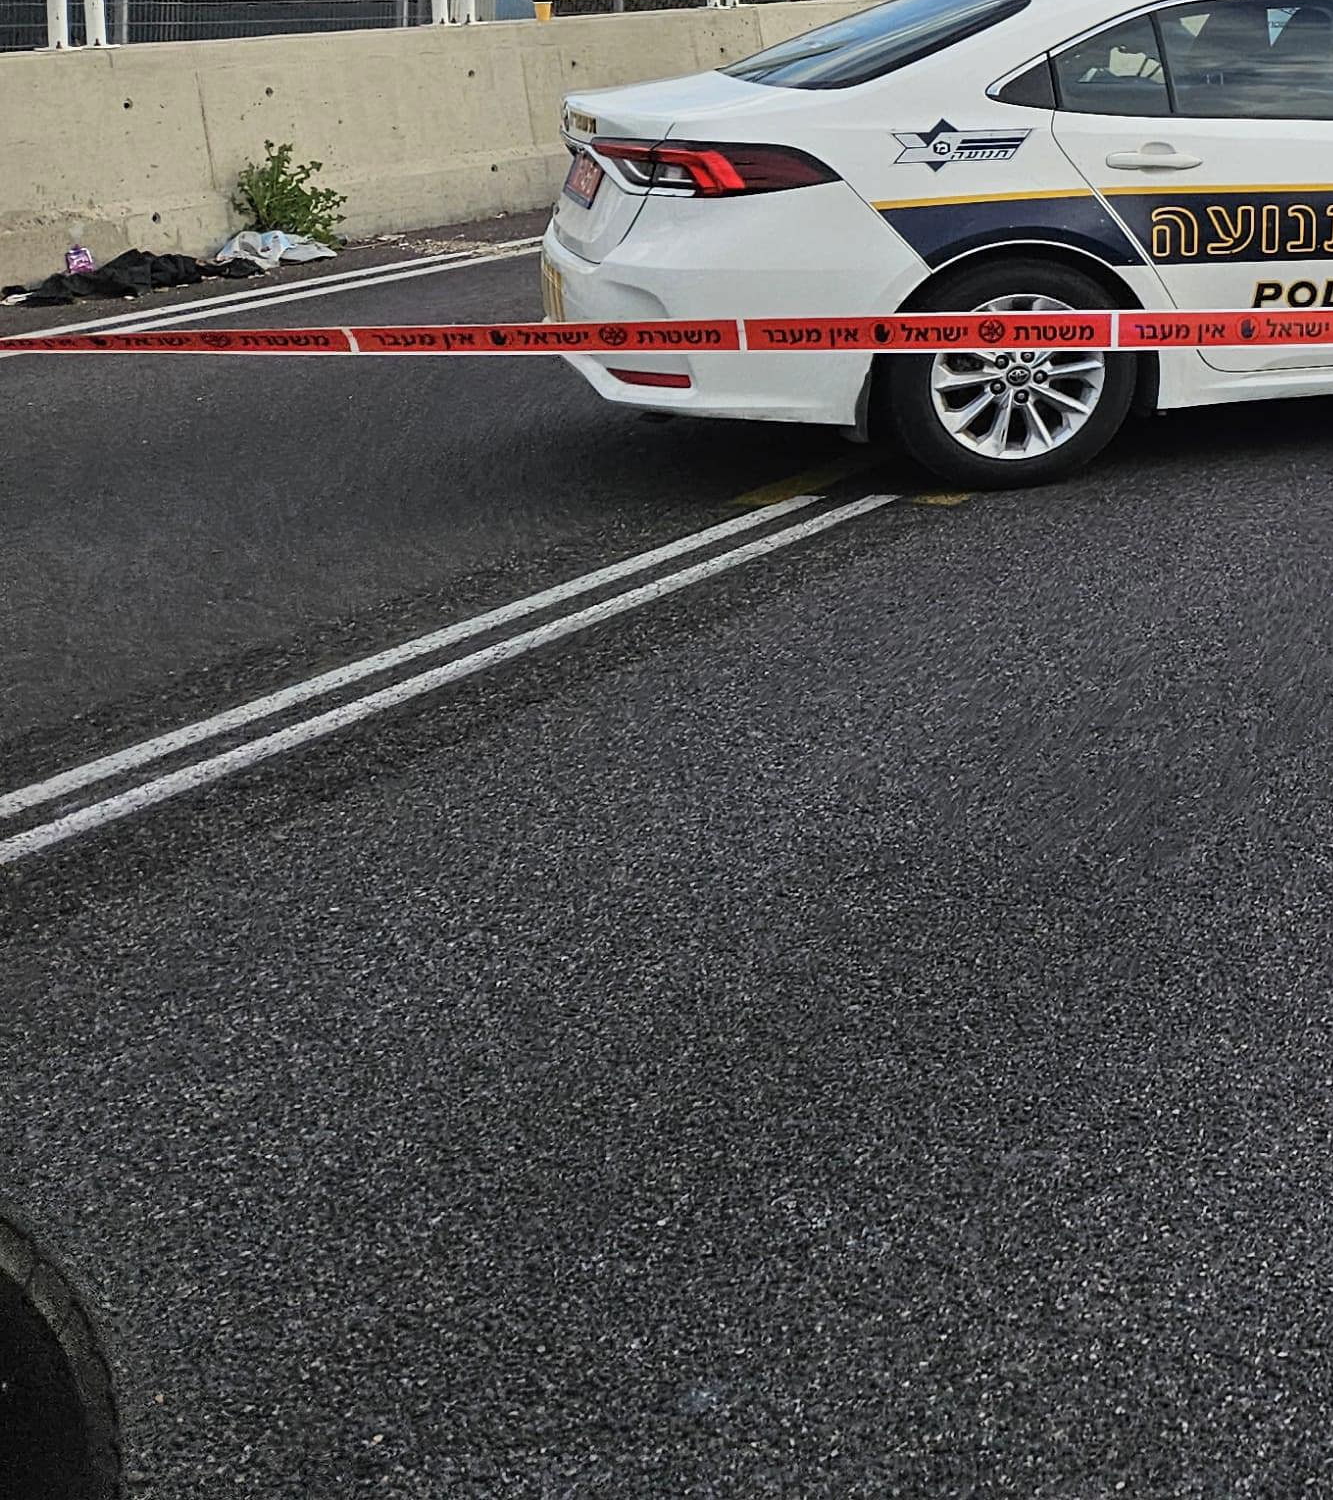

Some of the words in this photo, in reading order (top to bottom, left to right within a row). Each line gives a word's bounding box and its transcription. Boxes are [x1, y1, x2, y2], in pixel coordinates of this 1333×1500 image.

[950, 149, 1010, 160] תנועה
[763, 329, 822, 344] מעבר
[901, 324, 968, 342] ישראל
[1014, 325, 1094, 341] משטרת
[1135, 324, 1190, 340] מעבר
[1198, 324, 1225, 344] אין
[1266, 319, 1329, 338] ישראל
[372, 334, 436, 346] מעבר
[442, 333, 475, 350] אין
[517, 330, 589, 345] ישראל
[637, 330, 721, 344] משטרת
[829, 329, 859, 346] אין
